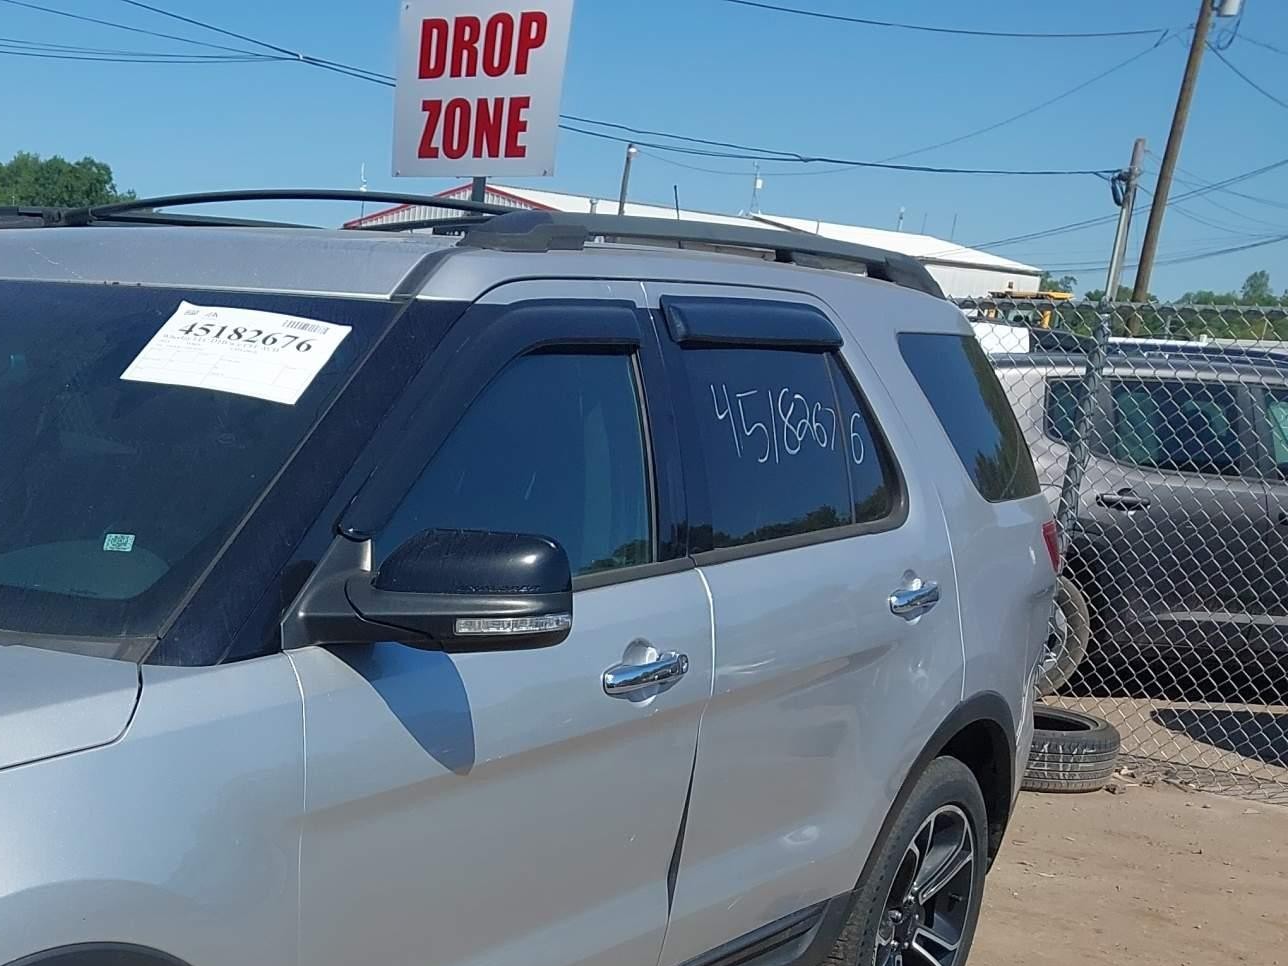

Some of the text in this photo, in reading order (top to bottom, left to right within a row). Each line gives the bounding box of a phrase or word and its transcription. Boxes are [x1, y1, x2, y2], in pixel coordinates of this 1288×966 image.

[418, 11, 548, 79] DROP
[418, 96, 531, 160] ZONE
[178, 321, 318, 353] 45182676
